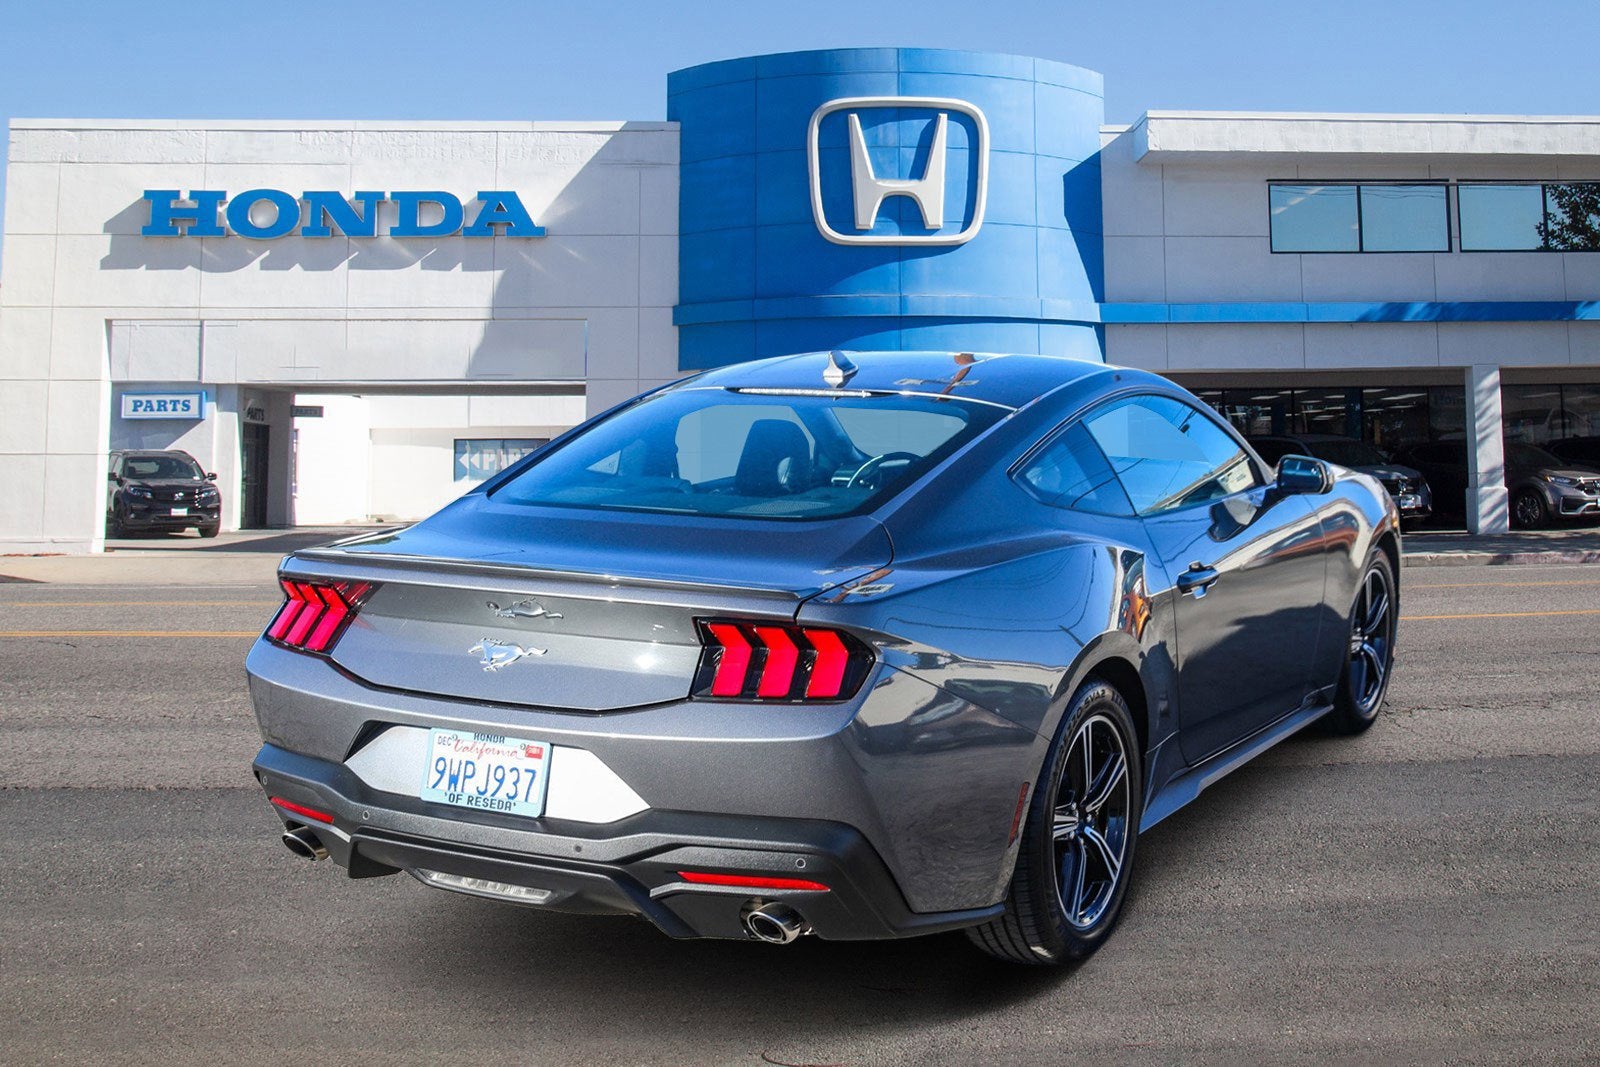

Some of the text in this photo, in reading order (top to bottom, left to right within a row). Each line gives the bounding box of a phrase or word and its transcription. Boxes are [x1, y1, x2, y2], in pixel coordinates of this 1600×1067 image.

[141, 188, 547, 240] HONDA
[131, 399, 191, 412] PARTS
[438, 736, 451, 746] DEC
[454, 740, 524, 760] California
[432, 757, 536, 802] 9WPJ937
